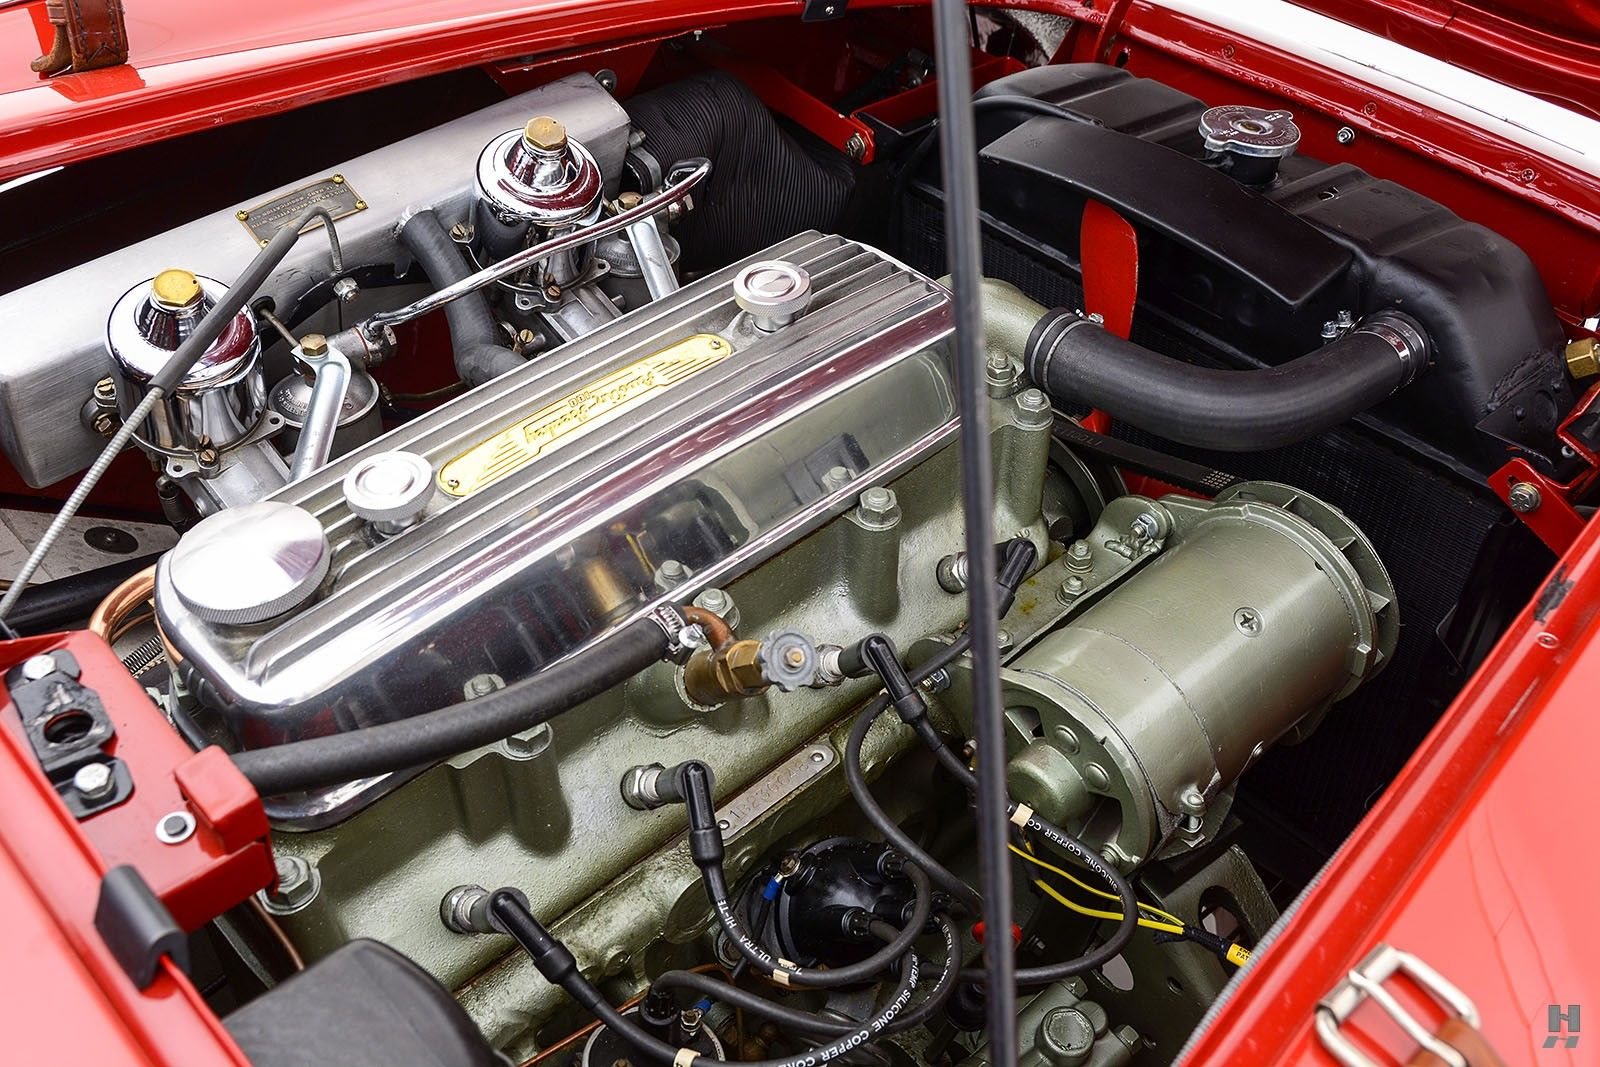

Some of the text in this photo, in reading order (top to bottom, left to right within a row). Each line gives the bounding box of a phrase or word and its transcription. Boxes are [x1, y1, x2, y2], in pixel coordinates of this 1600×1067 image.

[1044, 828, 1082, 857] COPPER
[1084, 855, 1119, 892] SILICONE
[740, 935, 772, 963] ULTRA
[871, 989, 911, 1032] SILICONE
[820, 1030, 870, 1062] COPPER
